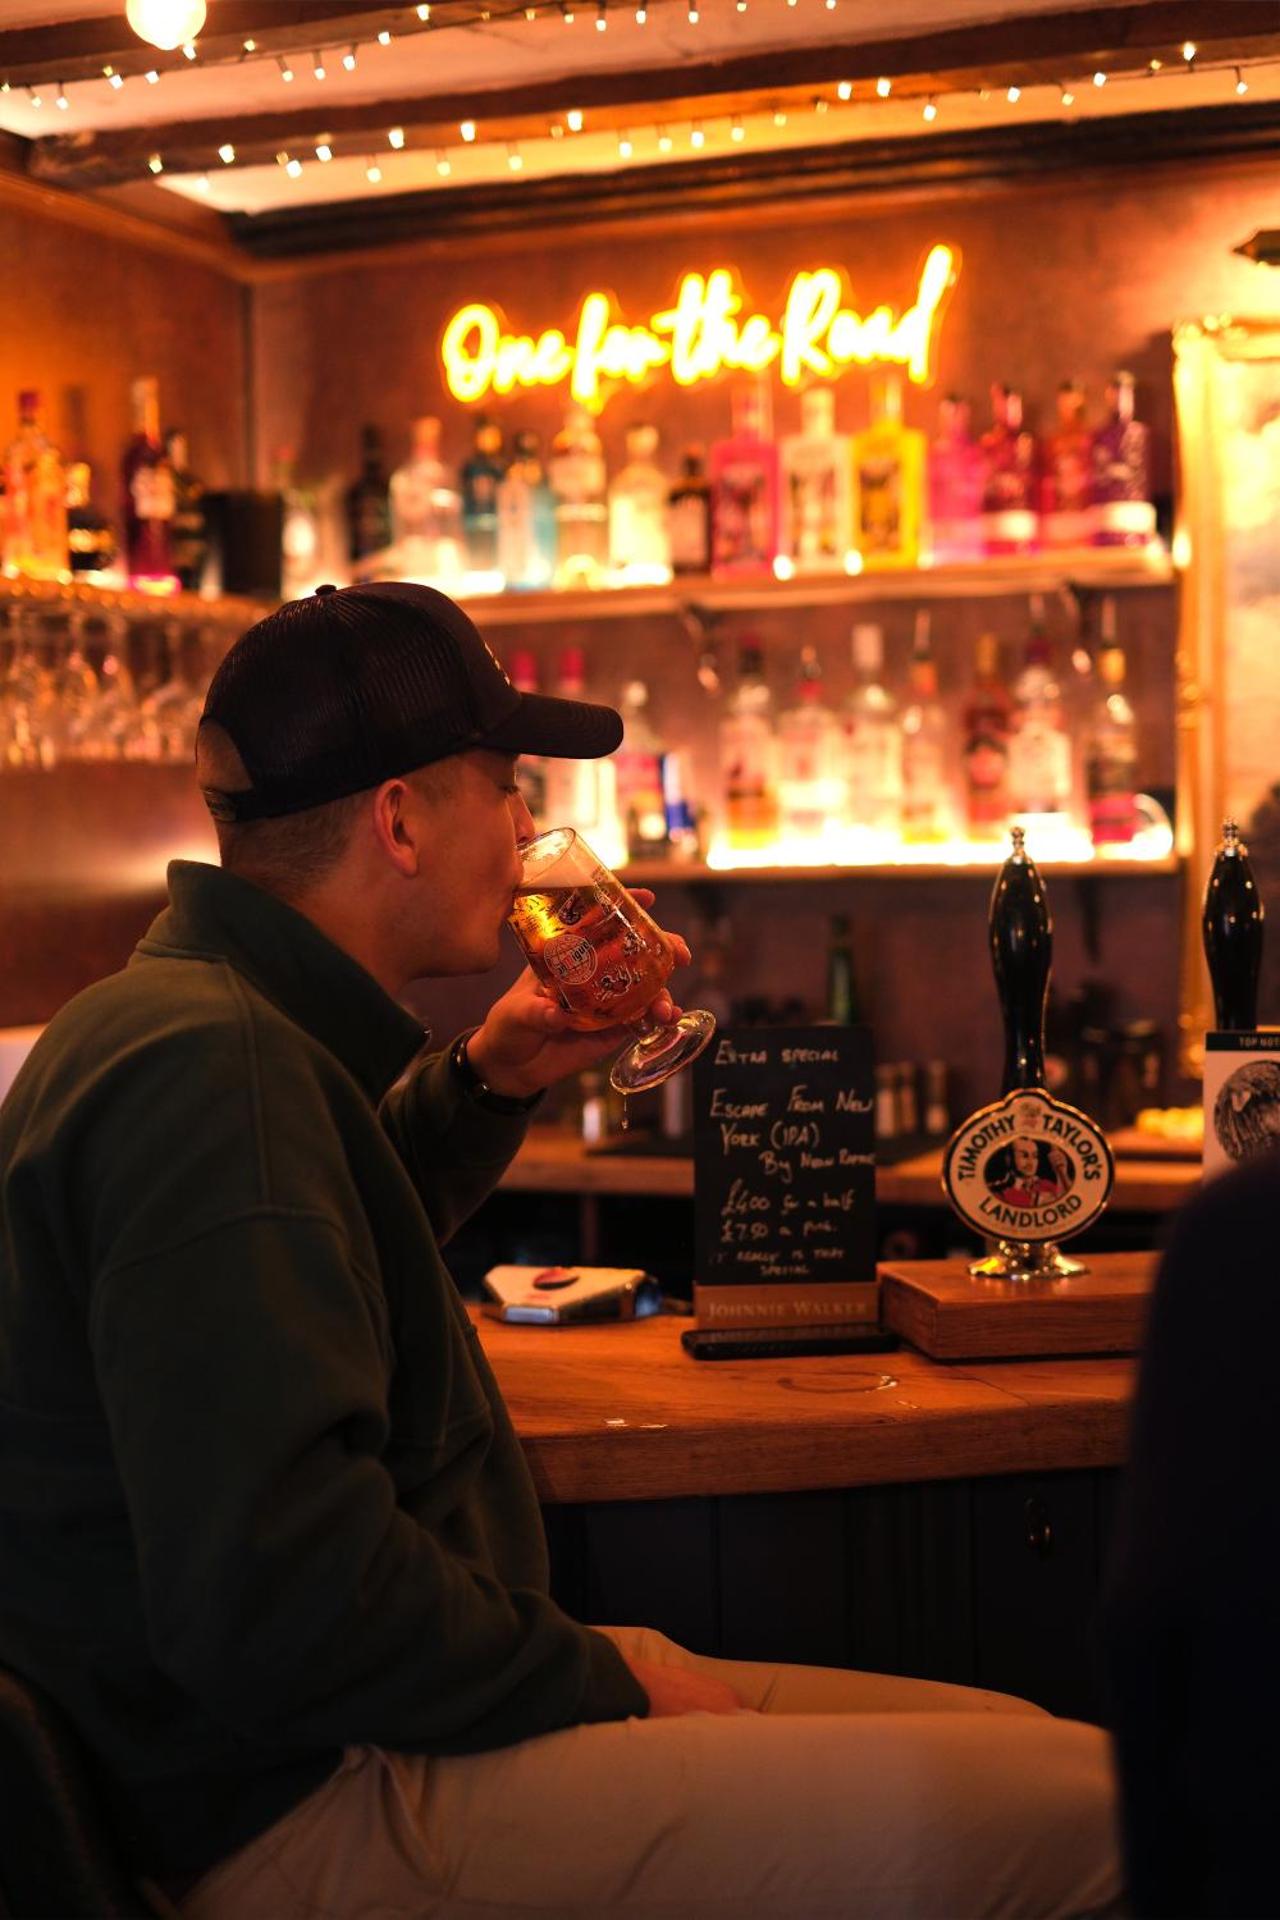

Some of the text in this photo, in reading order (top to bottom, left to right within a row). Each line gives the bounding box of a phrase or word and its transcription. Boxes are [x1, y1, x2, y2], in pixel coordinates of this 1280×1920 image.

[443, 304, 573, 402] One
[651, 268, 782, 385] the
[782, 245, 953, 386] Road
[770, 1121, 820, 1149] (IPA)
[958, 1115, 1102, 1181] TIMOTHY TAYLOR'S
[978, 1195, 1083, 1228] LANDLORD
[779, 1226, 791, 1236] a
